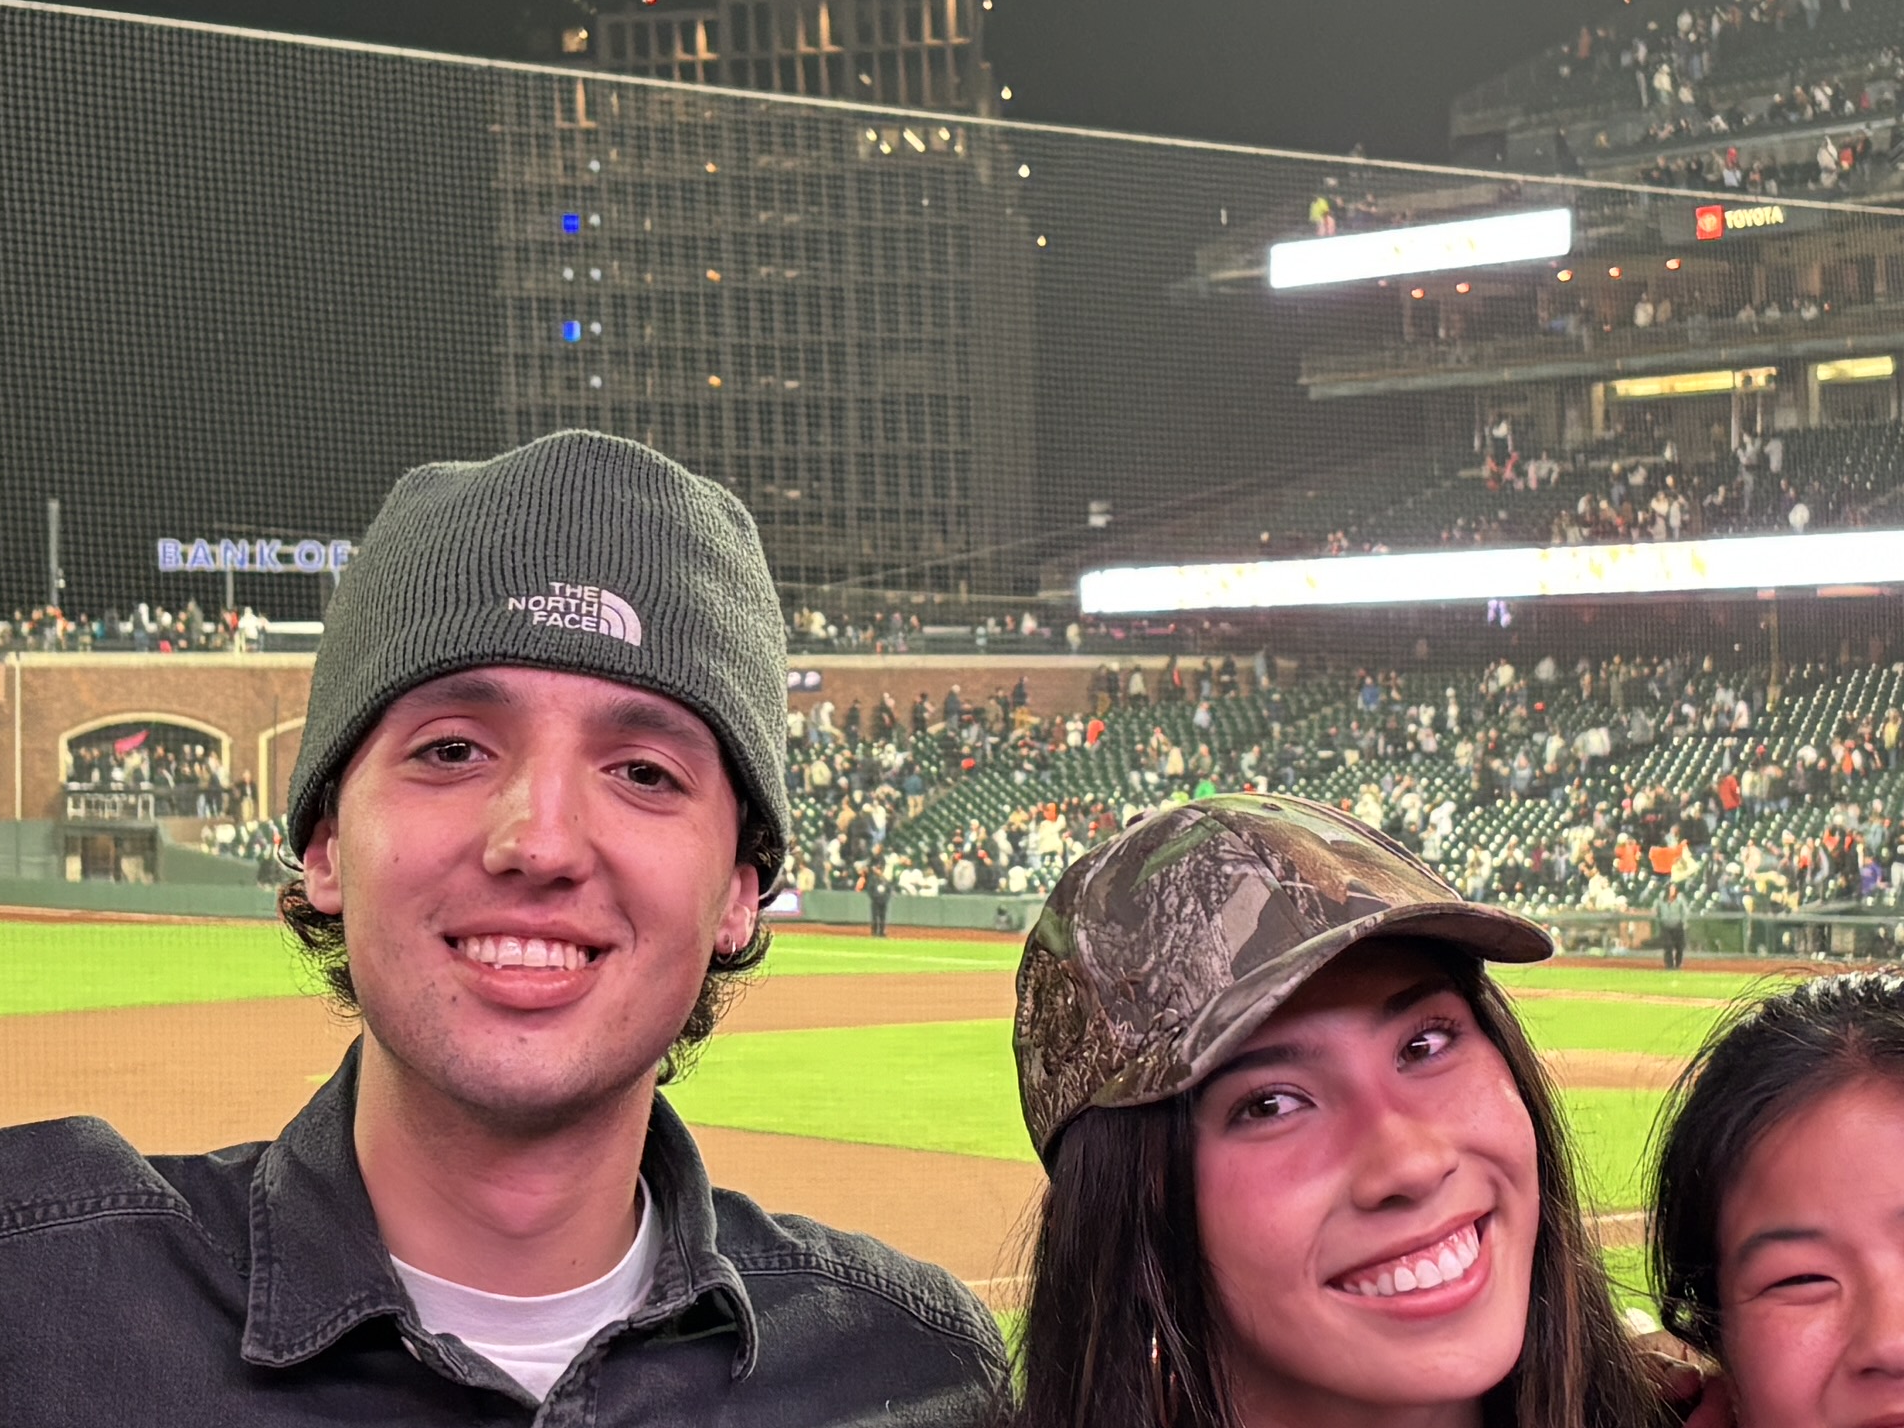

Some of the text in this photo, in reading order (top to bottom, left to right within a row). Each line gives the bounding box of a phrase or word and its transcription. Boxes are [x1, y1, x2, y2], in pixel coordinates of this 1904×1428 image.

[1724, 206, 1785, 229] TOYOTA
[158, 537, 353, 573] BANK OF
[549, 581, 600, 601] THE
[508, 595, 599, 616] NORTH
[532, 610, 598, 632] FACE
